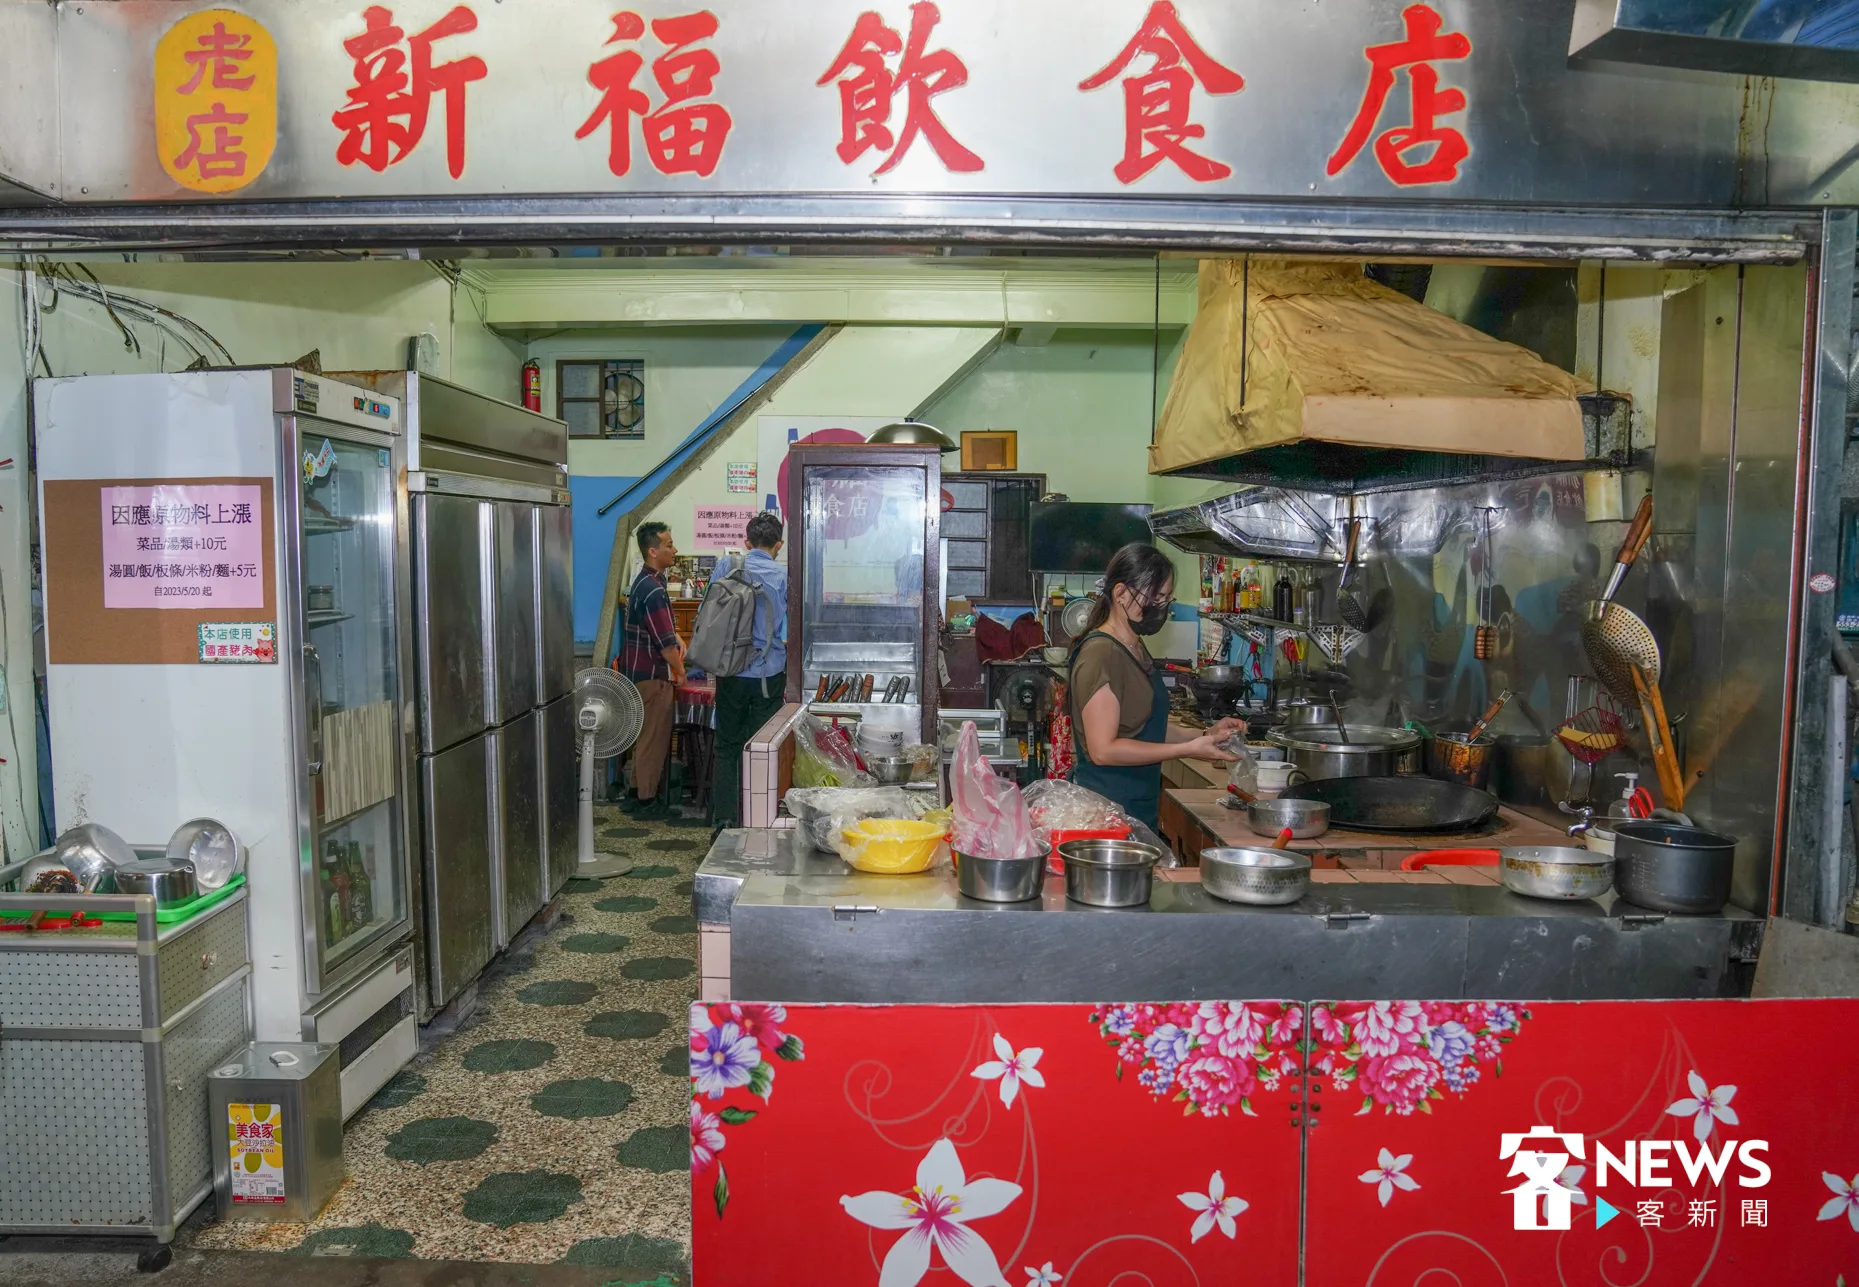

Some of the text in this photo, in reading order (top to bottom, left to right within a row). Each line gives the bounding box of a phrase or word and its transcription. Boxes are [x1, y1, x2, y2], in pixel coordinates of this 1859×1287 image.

[174, 21, 256, 180] 老店
[331, 0, 1472, 187] 新福飲食店
[112, 503, 252, 526] 因應原物料上漲
[137, 536, 227, 551] 菜品/湯類+10元
[109, 563, 257, 578] 湯圓/飯/板條/米粉/麵+5元
[154, 586, 212, 597] 自2023/5/20 起
[204, 628, 252, 640] 本店使用
[205, 644, 253, 656] 國產豬肉
[236, 1122, 274, 1139] 美食家
[237, 1139, 275, 1147] 大豆沙拉油
